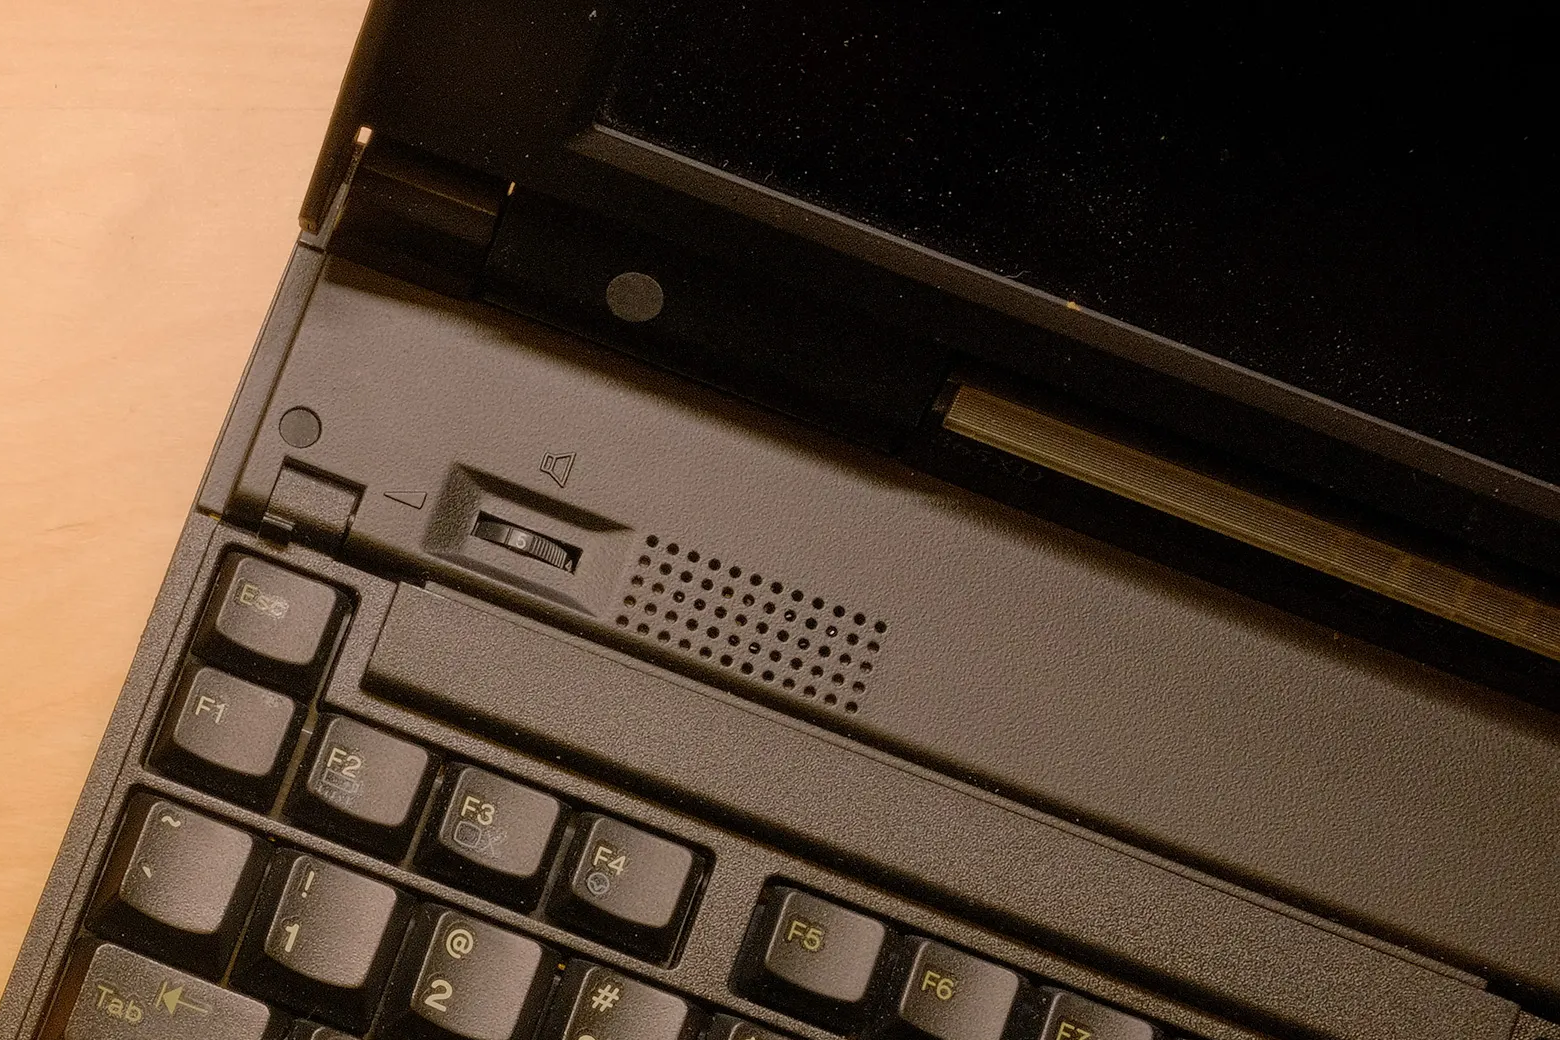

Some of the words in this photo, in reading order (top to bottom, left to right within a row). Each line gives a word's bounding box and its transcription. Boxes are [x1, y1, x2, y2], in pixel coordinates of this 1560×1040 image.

[515, 533, 528, 549] 5
[240, 583, 289, 618] Esc
[195, 696, 227, 724] F1
[327, 749, 363, 778] F2
[462, 796, 495, 826] F3
[592, 846, 626, 876] F4
[301, 870, 316, 899] !
[283, 922, 300, 953] 1
[445, 928, 475, 959] @
[787, 921, 823, 952] F5
[425, 979, 454, 1012] 2
[591, 984, 620, 1013] #
[922, 971, 954, 1001] F6
[95, 986, 143, 1023] Tab
